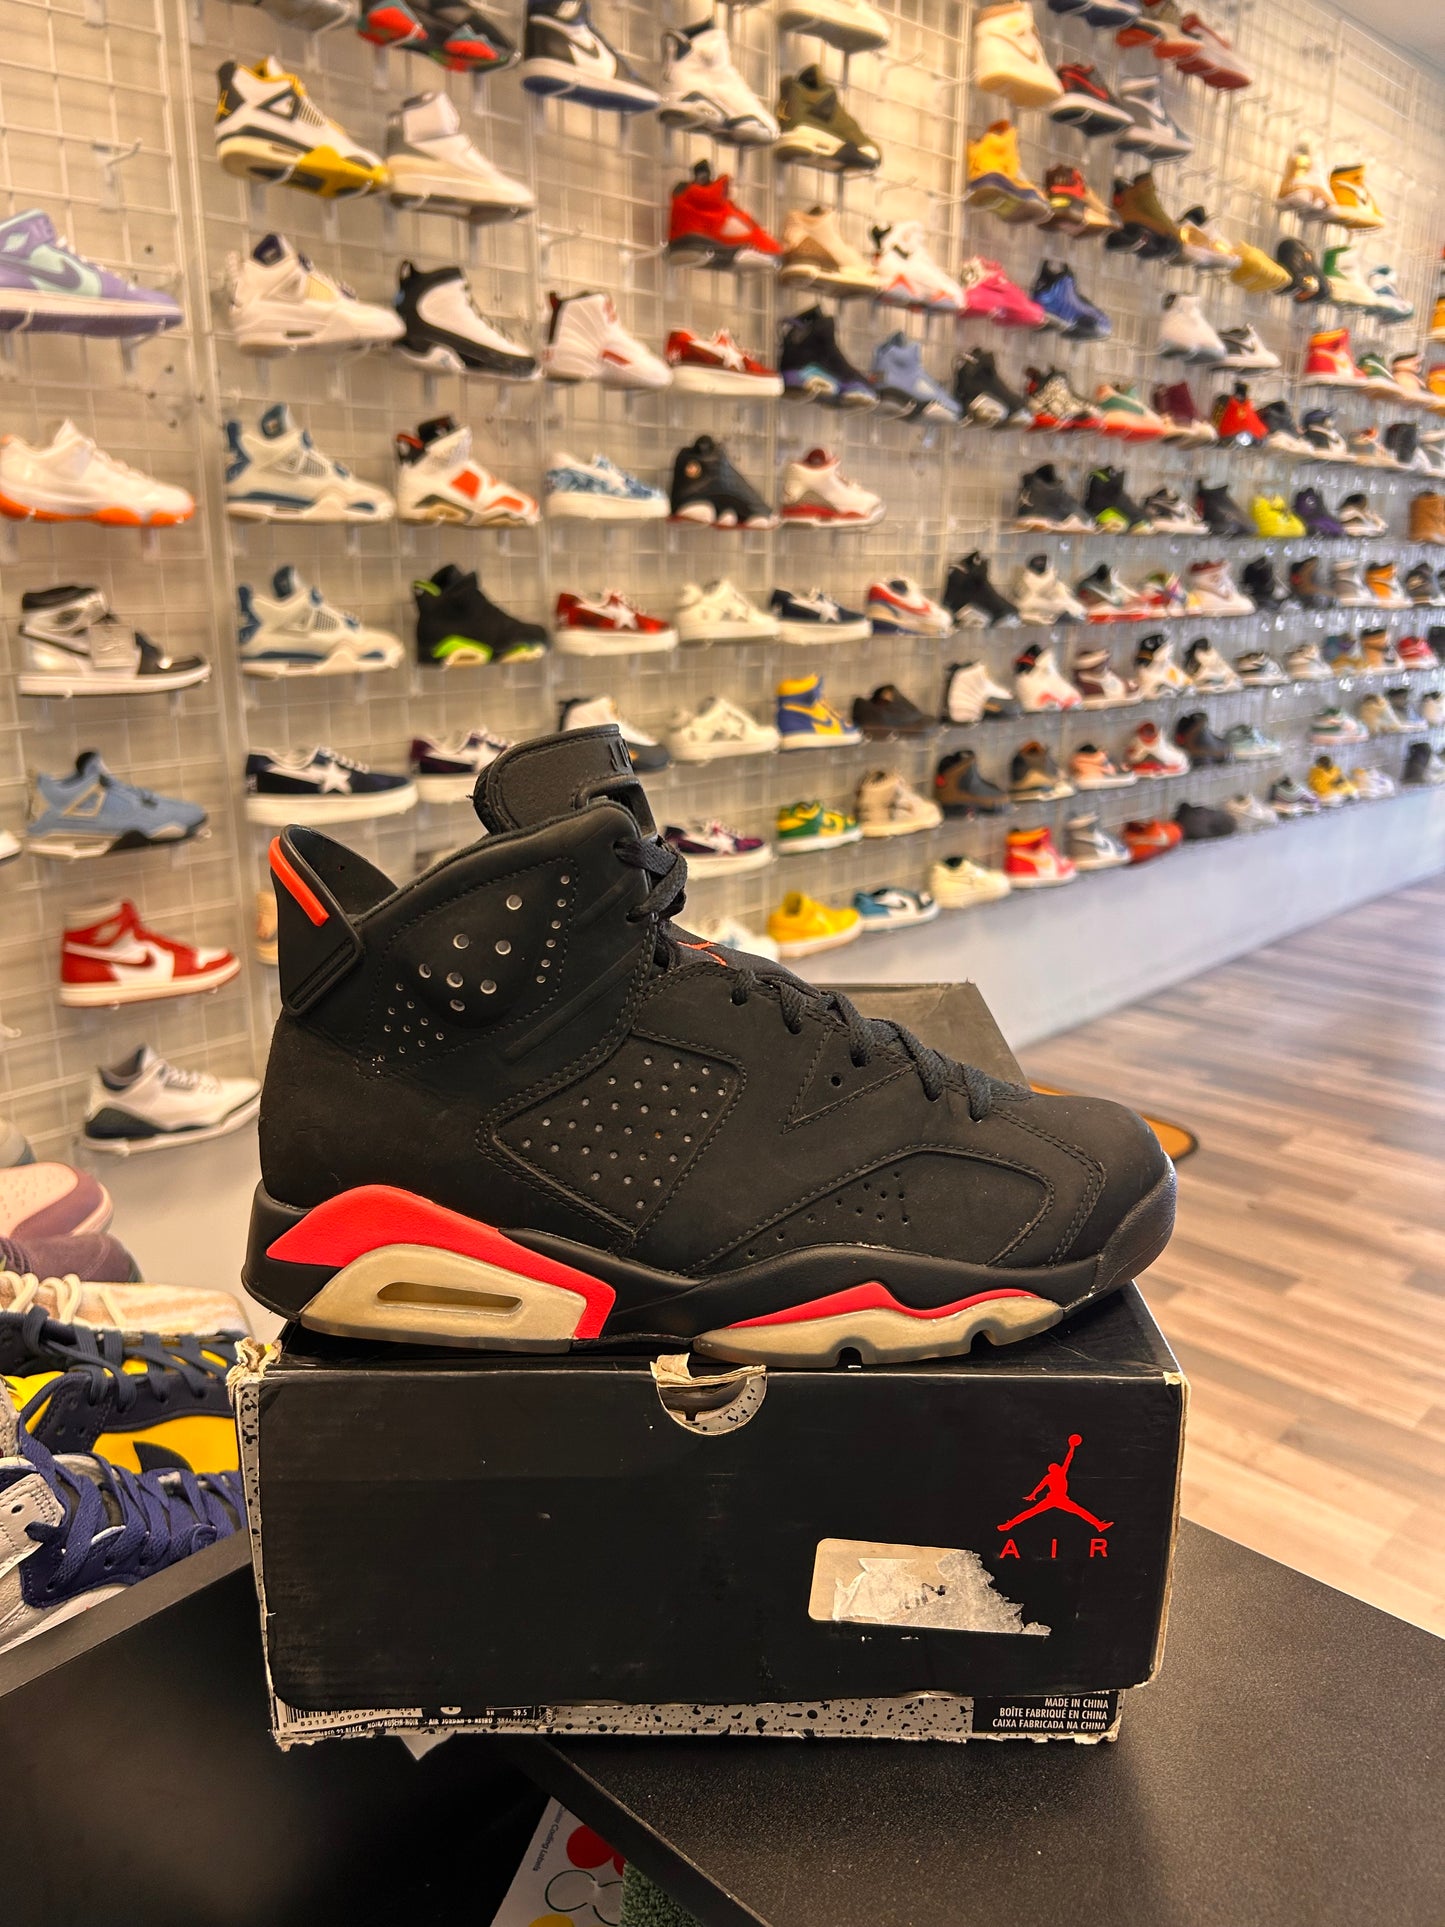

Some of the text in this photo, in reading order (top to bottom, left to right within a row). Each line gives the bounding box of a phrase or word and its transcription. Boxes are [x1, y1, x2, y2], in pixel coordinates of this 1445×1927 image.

[999, 1538, 1108, 1560] AIR
[1044, 1697, 1109, 1709] MADE IN CHINA
[513, 1708, 528, 1716] 39.5
[999, 1705, 1108, 1720] BOÎTE FABRIQUÉ EN CHINA
[992, 1718, 1106, 1730] CAIXA FABRICADA NA CHINA
